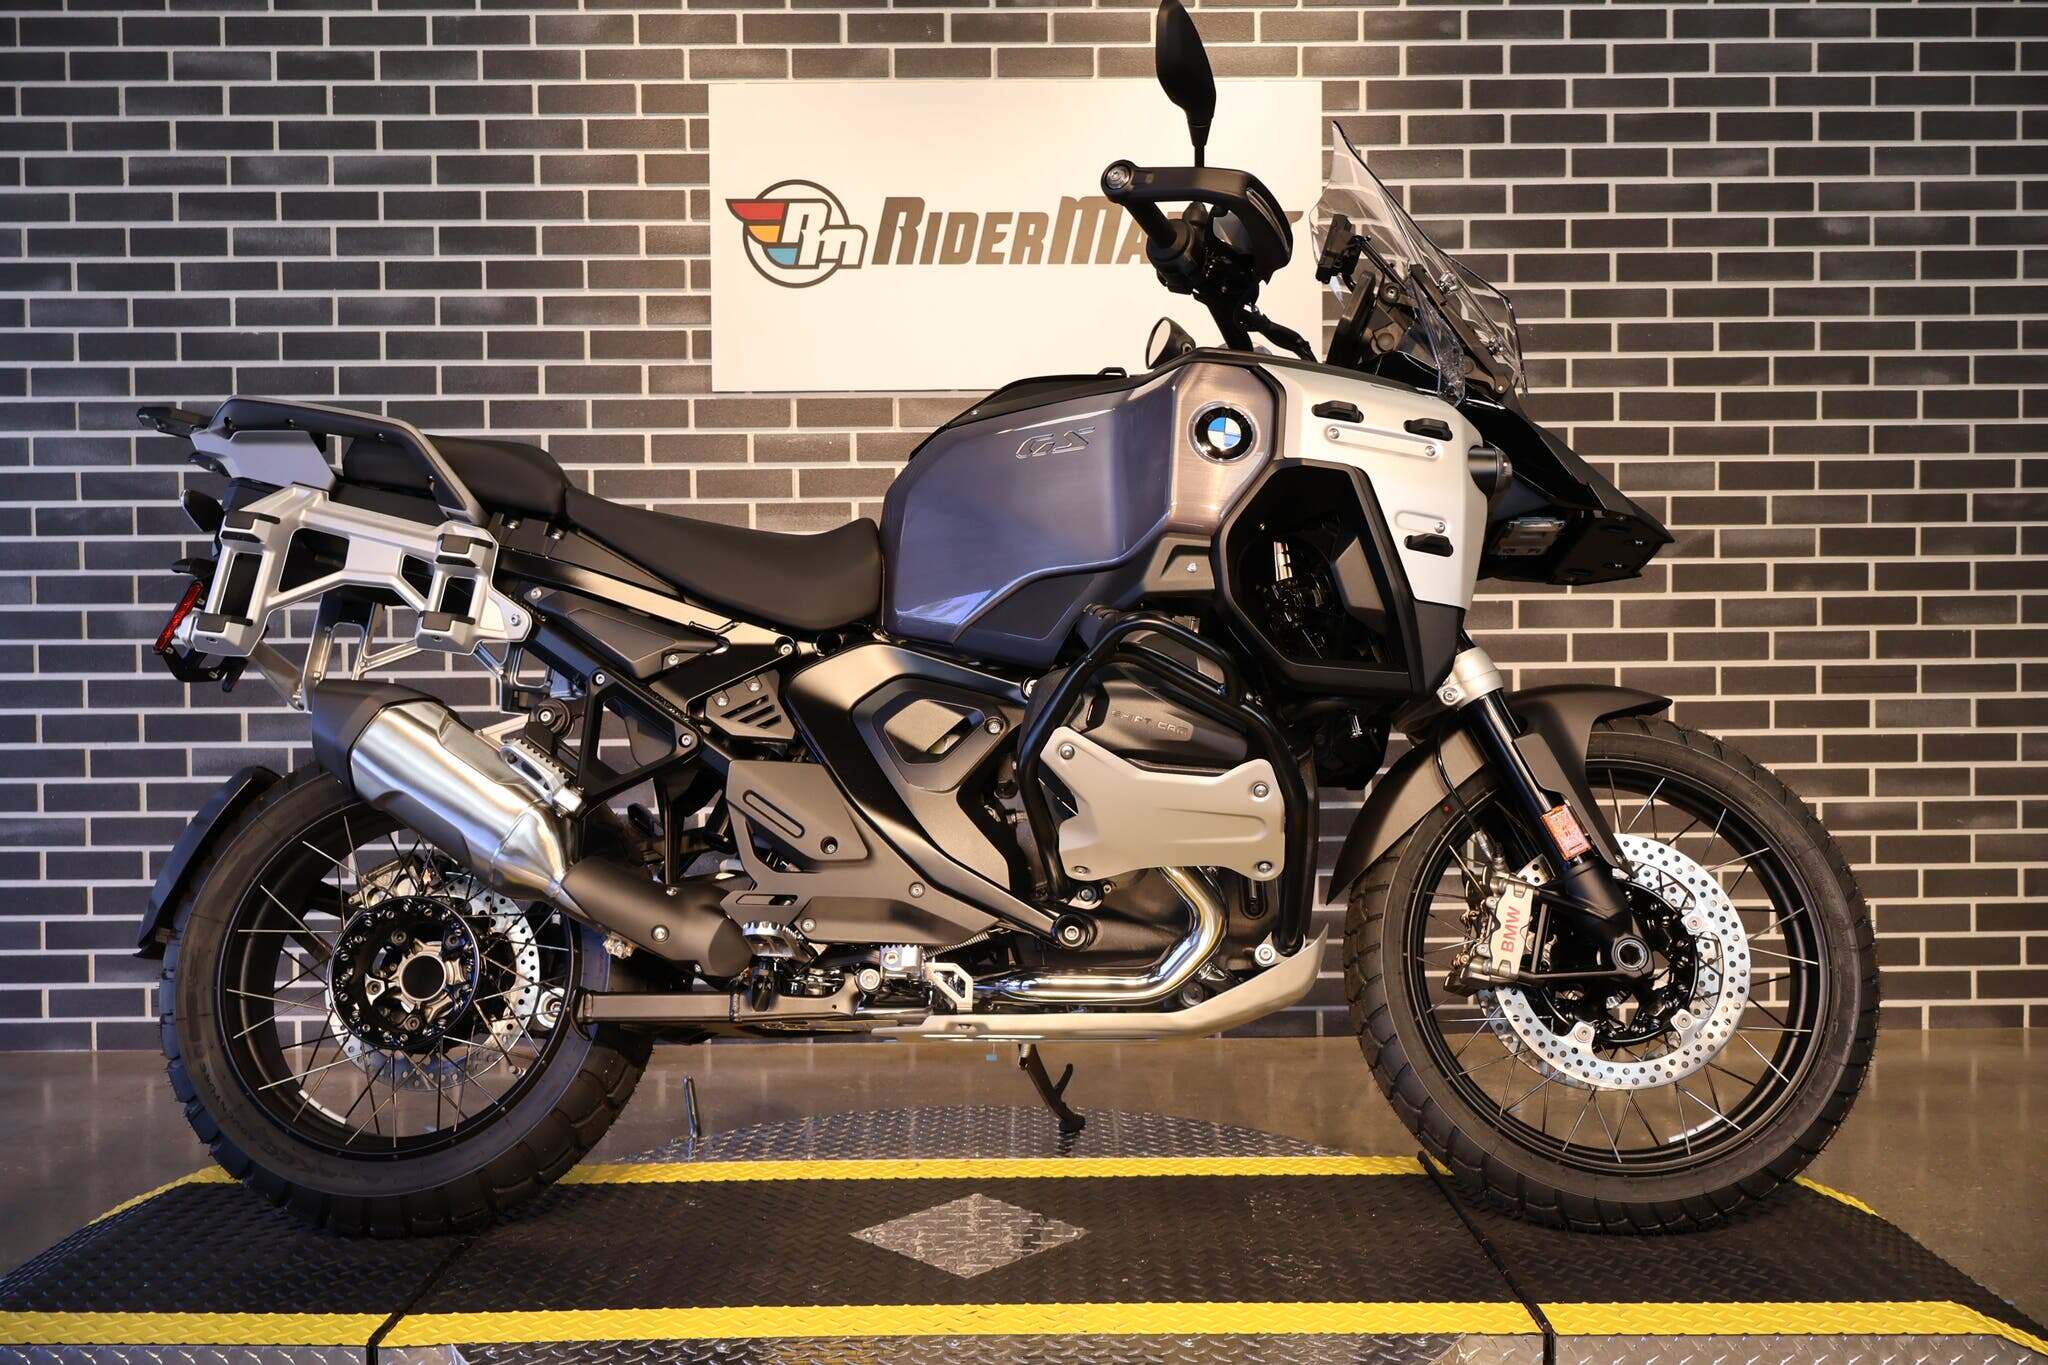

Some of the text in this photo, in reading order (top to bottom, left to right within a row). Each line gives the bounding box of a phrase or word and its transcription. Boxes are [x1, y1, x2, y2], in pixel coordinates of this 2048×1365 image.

[871, 196, 1304, 265] RIDERMA
[1015, 426, 1096, 459] GS
[1501, 905, 1521, 953] BMW
